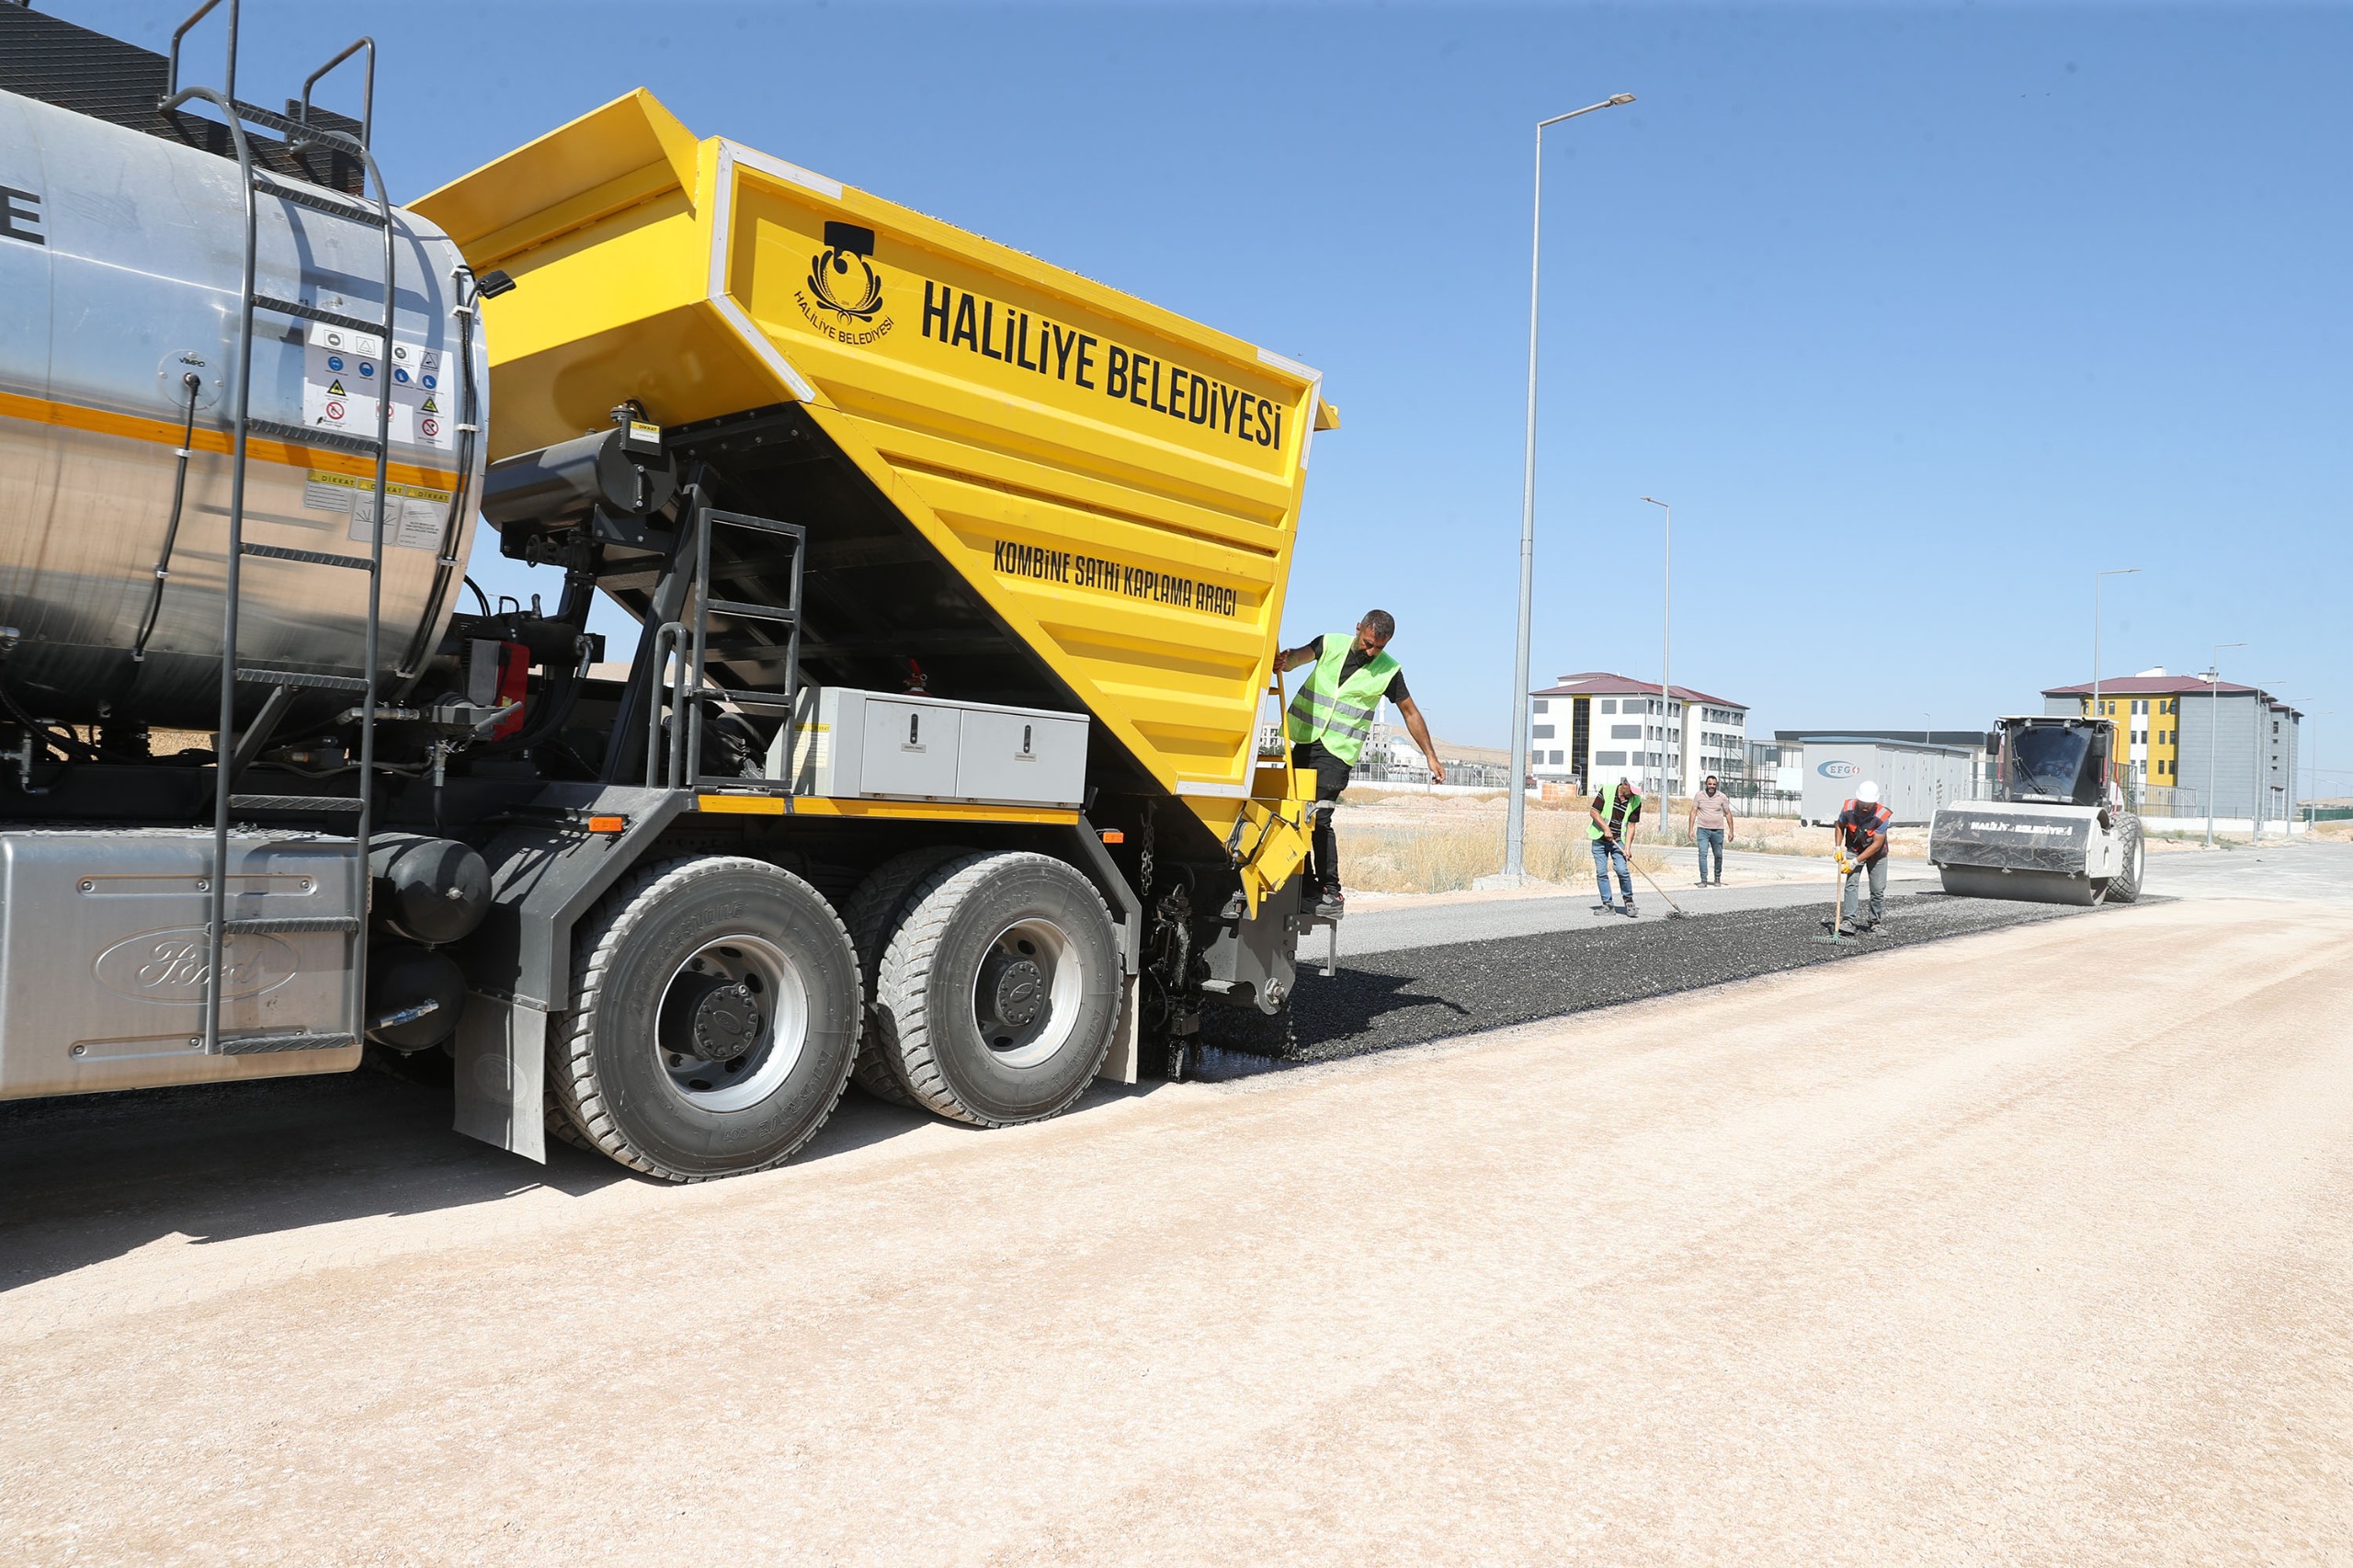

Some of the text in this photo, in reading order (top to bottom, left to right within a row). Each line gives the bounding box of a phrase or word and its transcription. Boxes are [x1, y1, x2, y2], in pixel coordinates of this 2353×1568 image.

[794, 290, 894, 345] HALİLİYE BELEDİYESİ
[922, 279, 1281, 450] HALİLİYE BELEDİYESİ
[370, 483, 402, 494] DKAT
[994, 540, 1237, 617] KOMBİNE SATHİ KAPLAMA ARACI
[1830, 766, 1850, 774] EFG
[1970, 821, 2015, 833] HALİLİY
